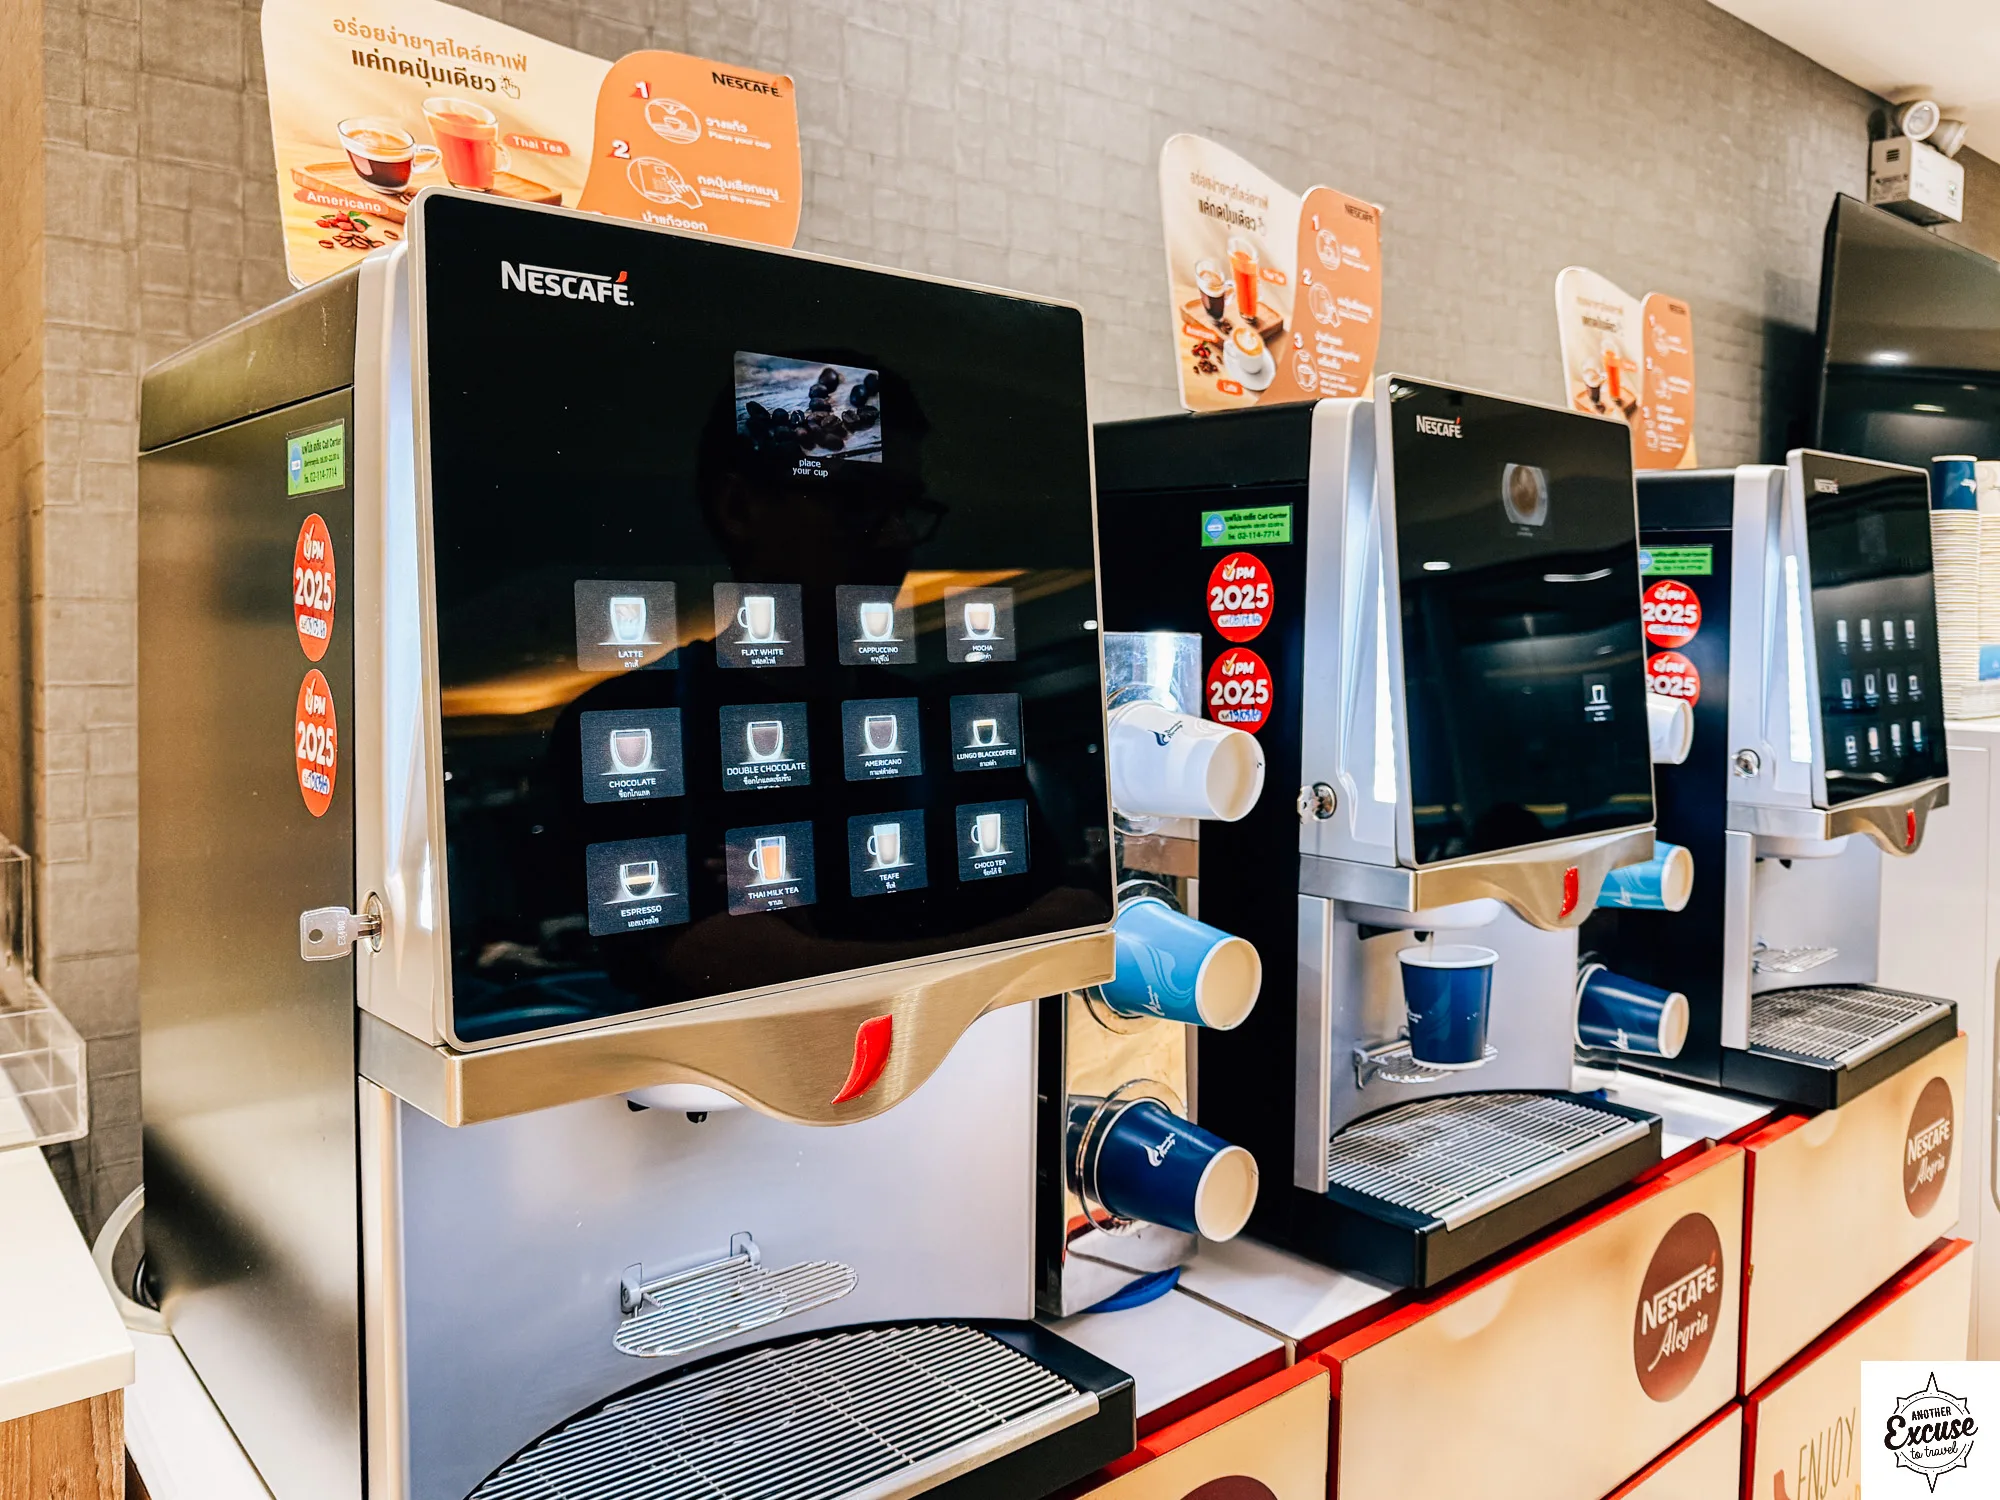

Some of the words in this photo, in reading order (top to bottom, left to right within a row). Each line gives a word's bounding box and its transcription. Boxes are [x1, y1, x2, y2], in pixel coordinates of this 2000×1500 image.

[351, 48, 496, 93] แค่กดปุ่มเดียว
[636, 80, 649, 99] 1
[512, 135, 542, 151] Thai
[543, 140, 564, 154] Tea
[612, 139, 630, 159] 2
[307, 190, 382, 213] Americano
[798, 458, 822, 470] place
[792, 466, 813, 477] your
[813, 468, 829, 479] cup
[294, 566, 332, 612] 2025
[1210, 583, 1269, 612] 2025
[1643, 602, 1698, 624] 2025
[618, 650, 644, 659] LATTE
[741, 649, 759, 657] FLAT
[759, 648, 784, 657] WHITE
[858, 646, 898, 654] CAPPUCCINO
[1210, 678, 1269, 706] 2025
[297, 720, 335, 768] 2025
[957, 751, 977, 760] LUNGO
[977, 749, 1017, 759] BLACKCOFFEE
[726, 765, 759, 776] DOUBLE
[760, 761, 806, 773] CHOCOLATE
[864, 758, 902, 768] AMERICANO
[609, 777, 656, 789] CHOCOLATE
[974, 859, 995, 870] CHOCO
[994, 859, 1007, 868] TEA
[879, 872, 900, 882] TEAFE
[748, 890, 766, 900] THAI
[766, 888, 784, 898] MILK
[784, 886, 800, 895] TEA
[620, 905, 663, 918] ESPRESSO
[1647, 1311, 1709, 1372] Alegria
[1797, 1407, 1857, 1500] ENJOY
